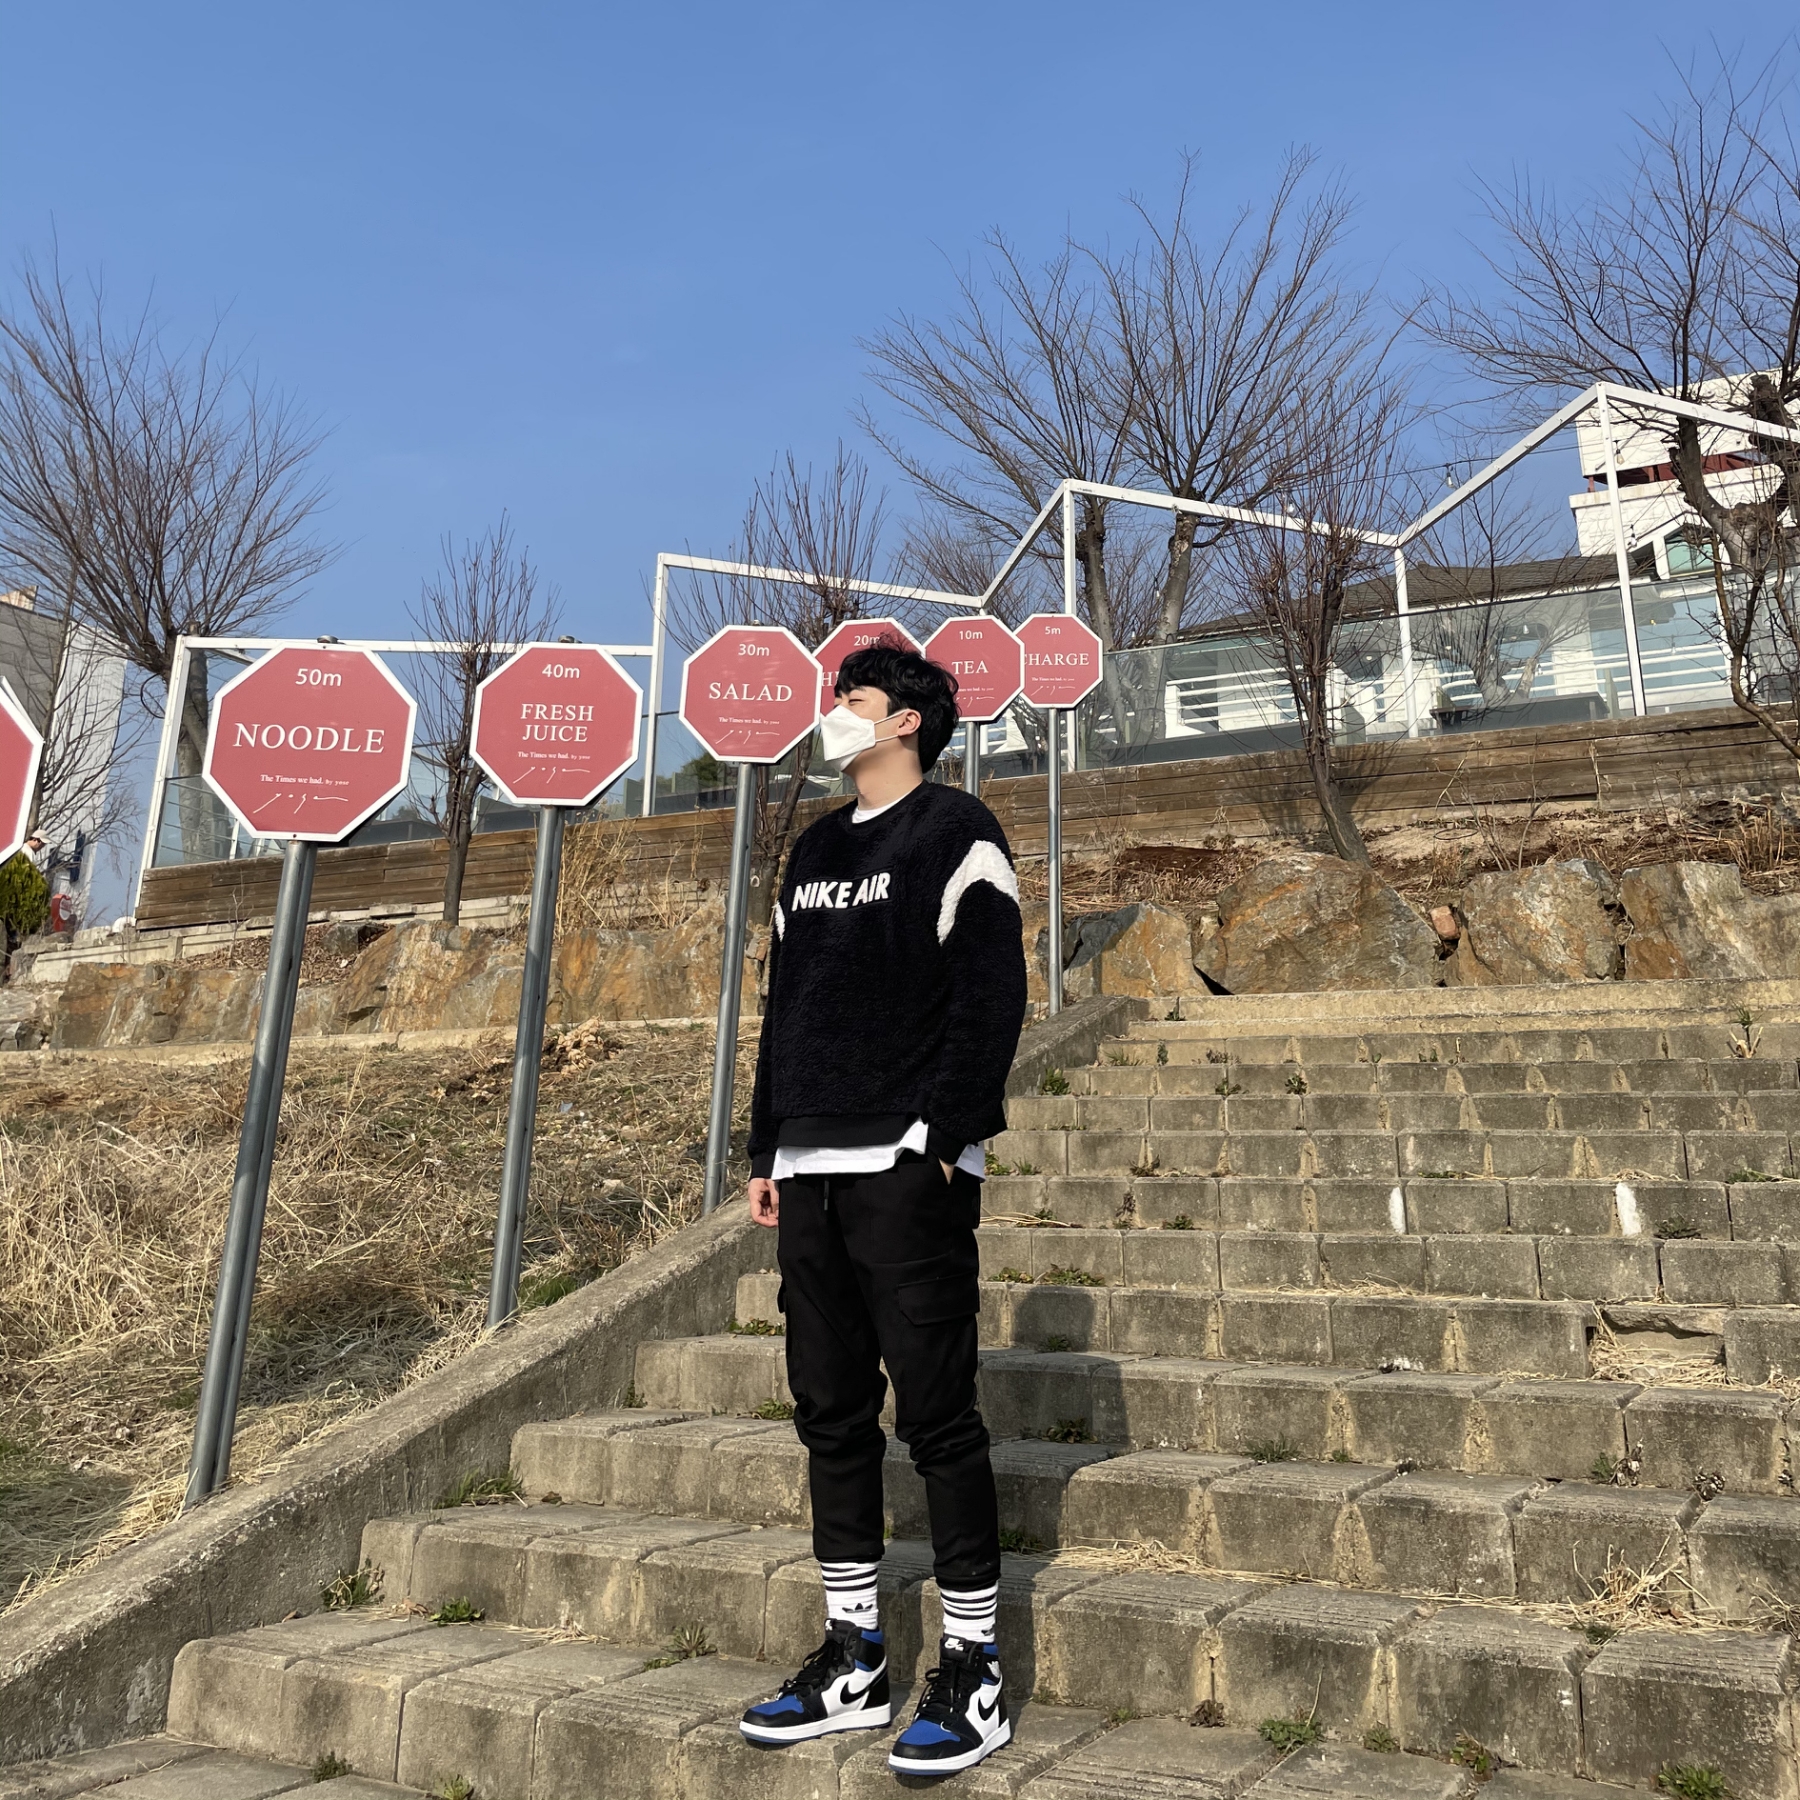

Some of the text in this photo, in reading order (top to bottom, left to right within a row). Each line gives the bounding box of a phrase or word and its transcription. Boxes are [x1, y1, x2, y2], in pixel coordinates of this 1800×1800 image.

[959, 630, 983, 640] 10m
[1045, 626, 1061, 635] 5m
[738, 644, 770, 656] 30m
[542, 664, 580, 678] 40m
[951, 660, 989, 675] TEA
[295, 668, 342, 686] 50m
[709, 682, 792, 702] SALAD
[520, 704, 594, 721] FRESH
[233, 723, 385, 753] NOODLE
[522, 725, 588, 742] JUICE
[260, 774, 274, 782] The
[275, 774, 296, 783] Times
[309, 776, 324, 785] had.
[791, 872, 891, 912] NIKE AIR
